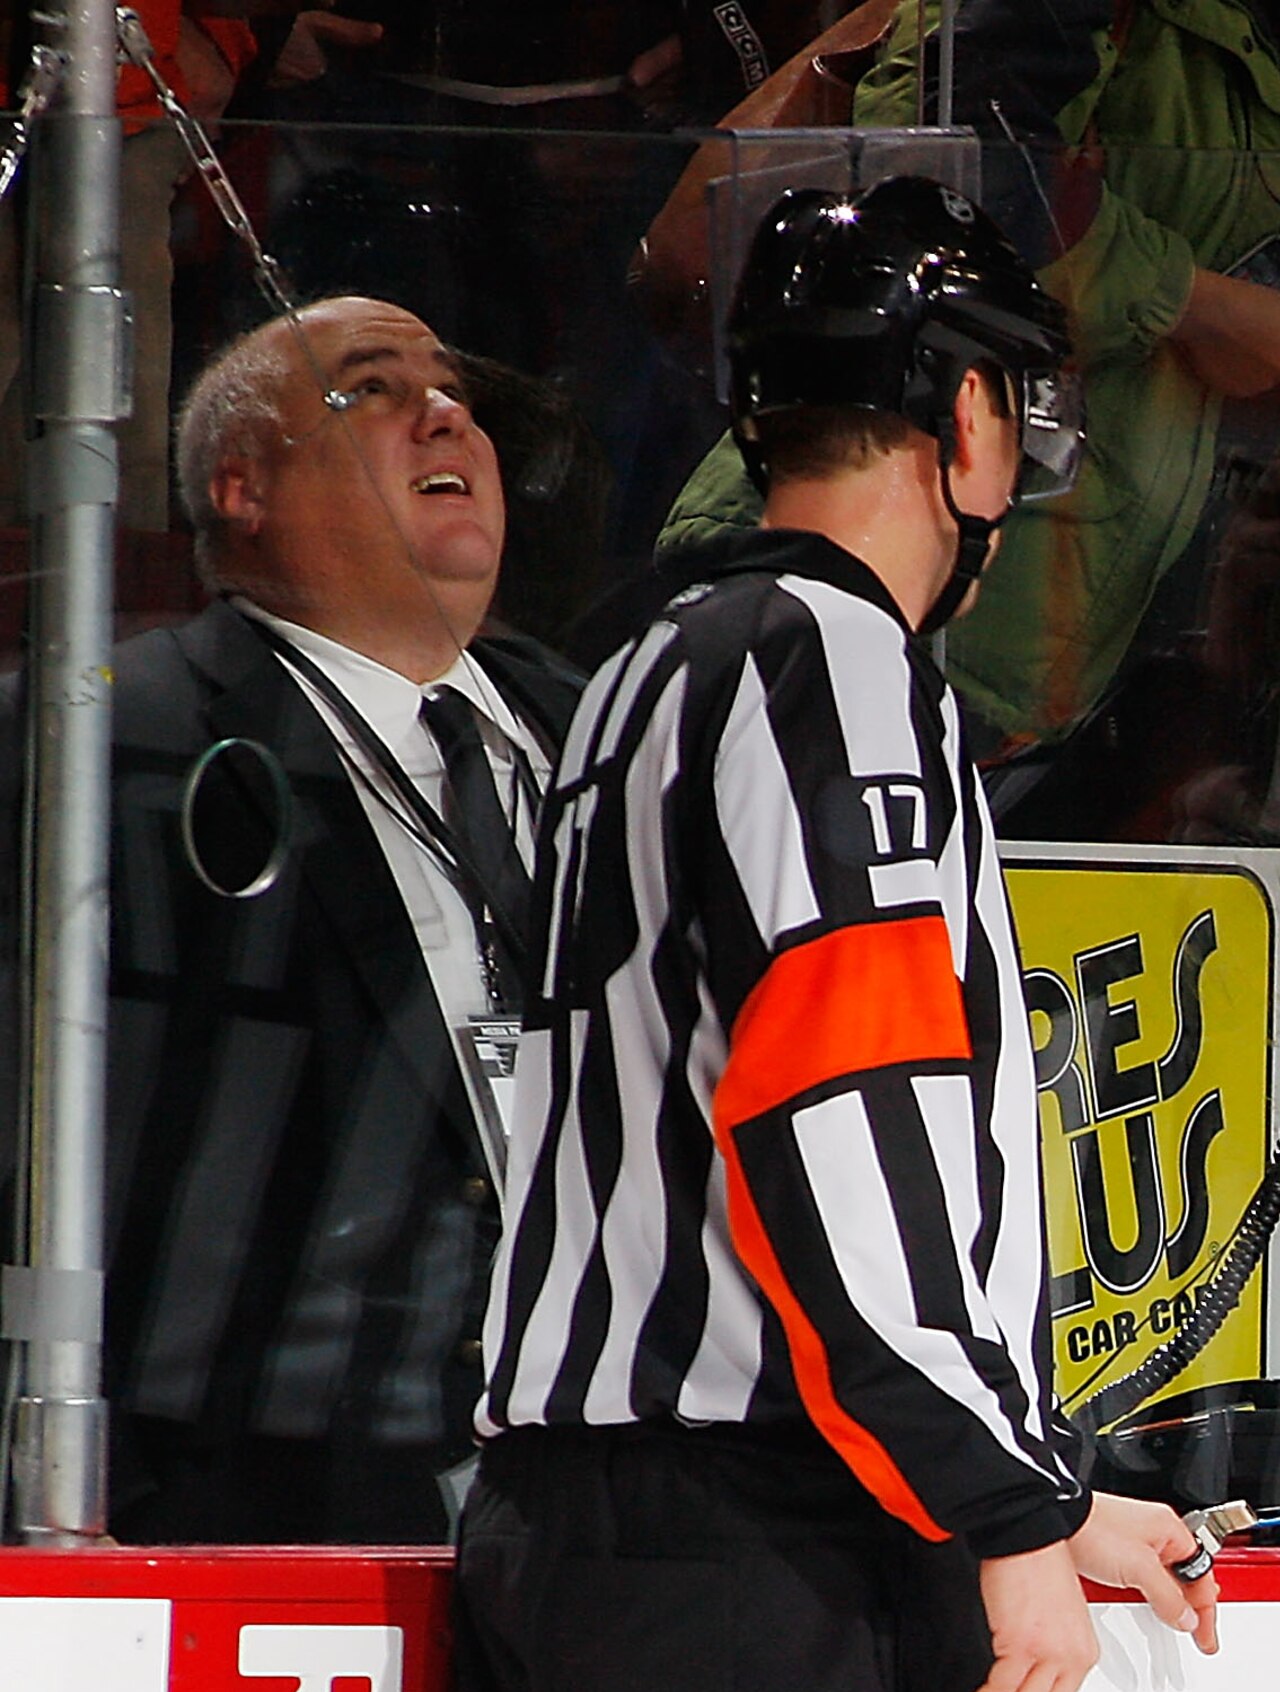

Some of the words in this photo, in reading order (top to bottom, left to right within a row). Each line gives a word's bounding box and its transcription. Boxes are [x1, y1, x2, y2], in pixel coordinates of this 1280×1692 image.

[861, 784, 927, 855] 17
[1067, 1311, 1138, 1363] CAR
[1149, 1284, 1212, 1335] CA
